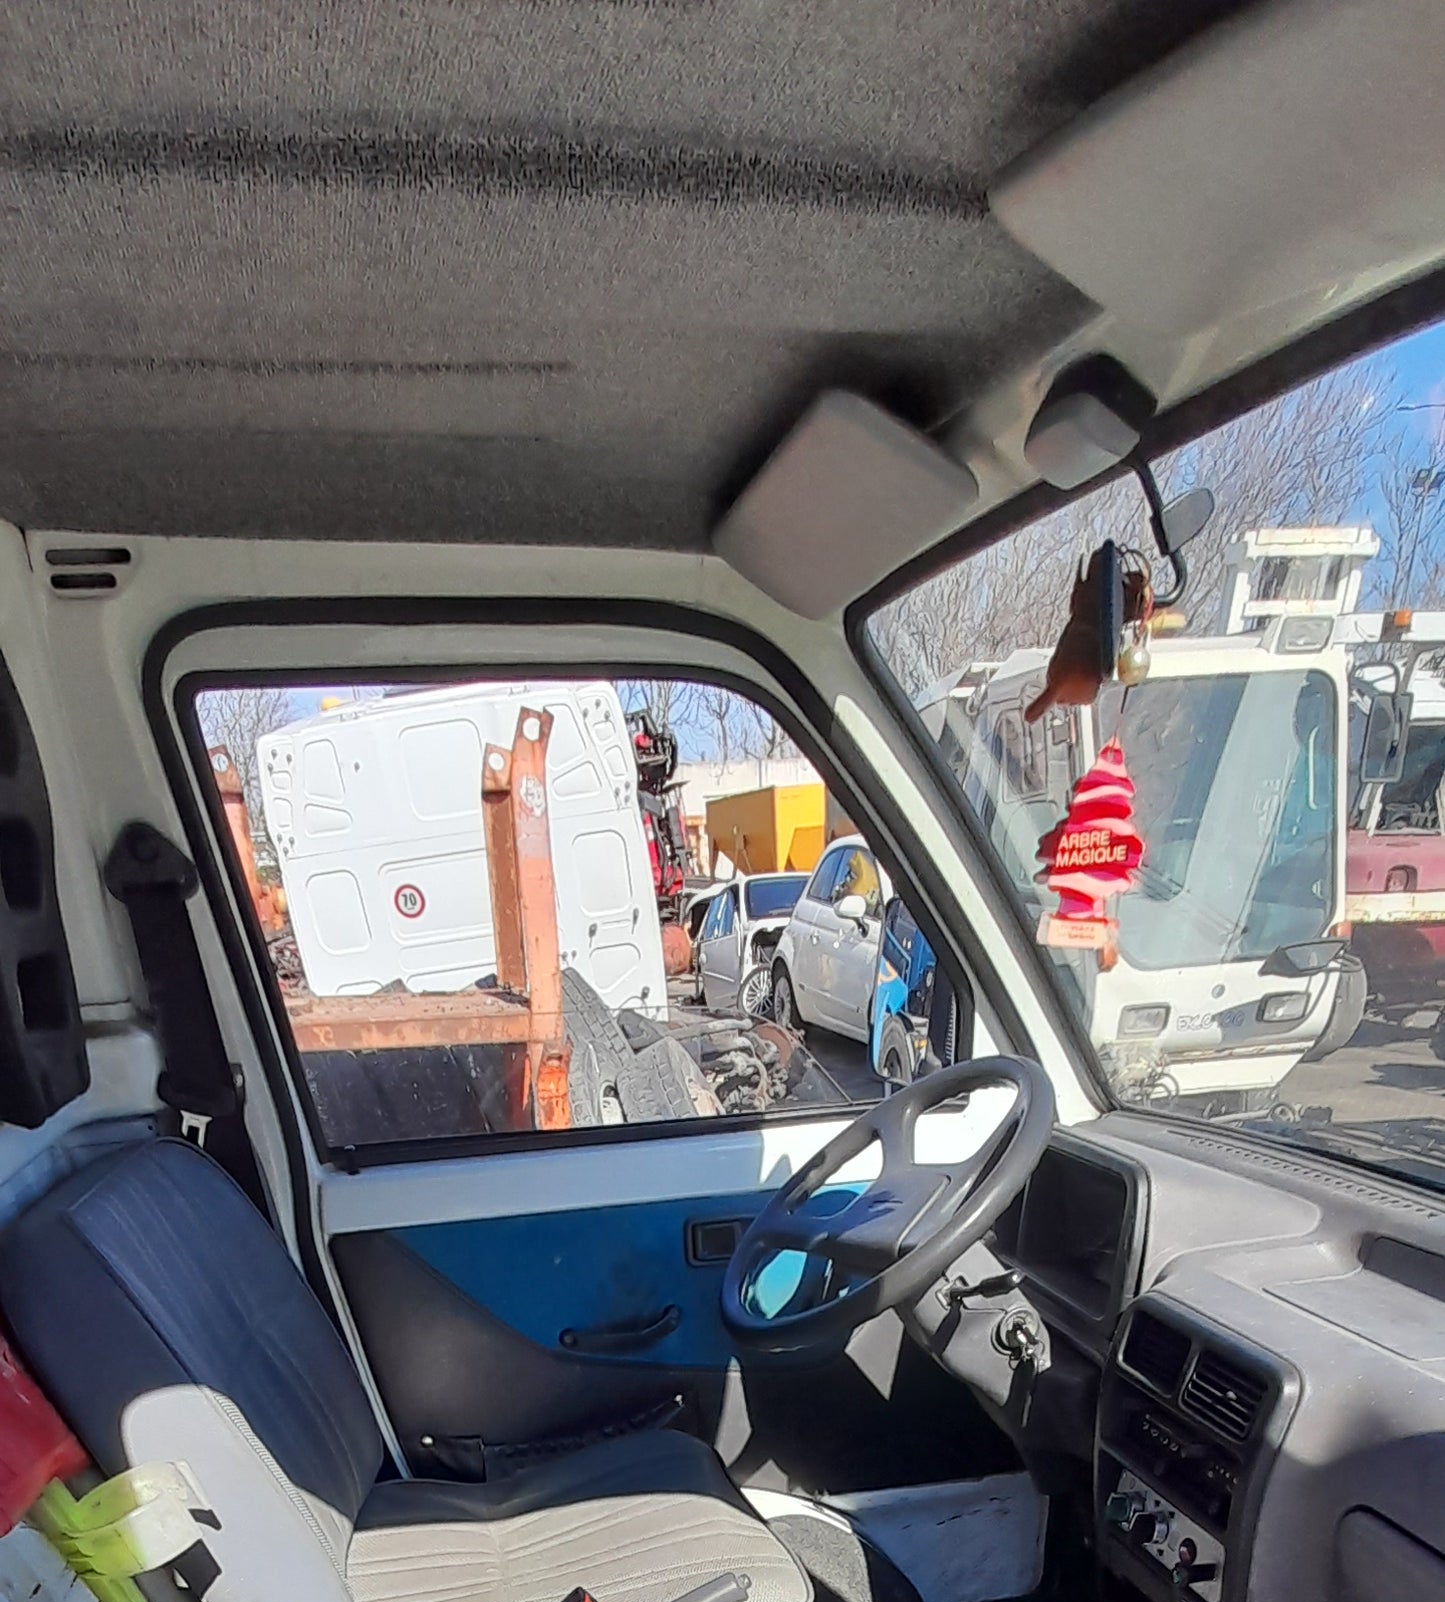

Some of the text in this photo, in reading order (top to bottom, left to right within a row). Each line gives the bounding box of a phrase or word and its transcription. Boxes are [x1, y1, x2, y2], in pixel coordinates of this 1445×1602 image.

[1058, 830, 1111, 851] ARBRE
[1055, 844, 1128, 868] MAGIQUE
[401, 892, 417, 908] 70
